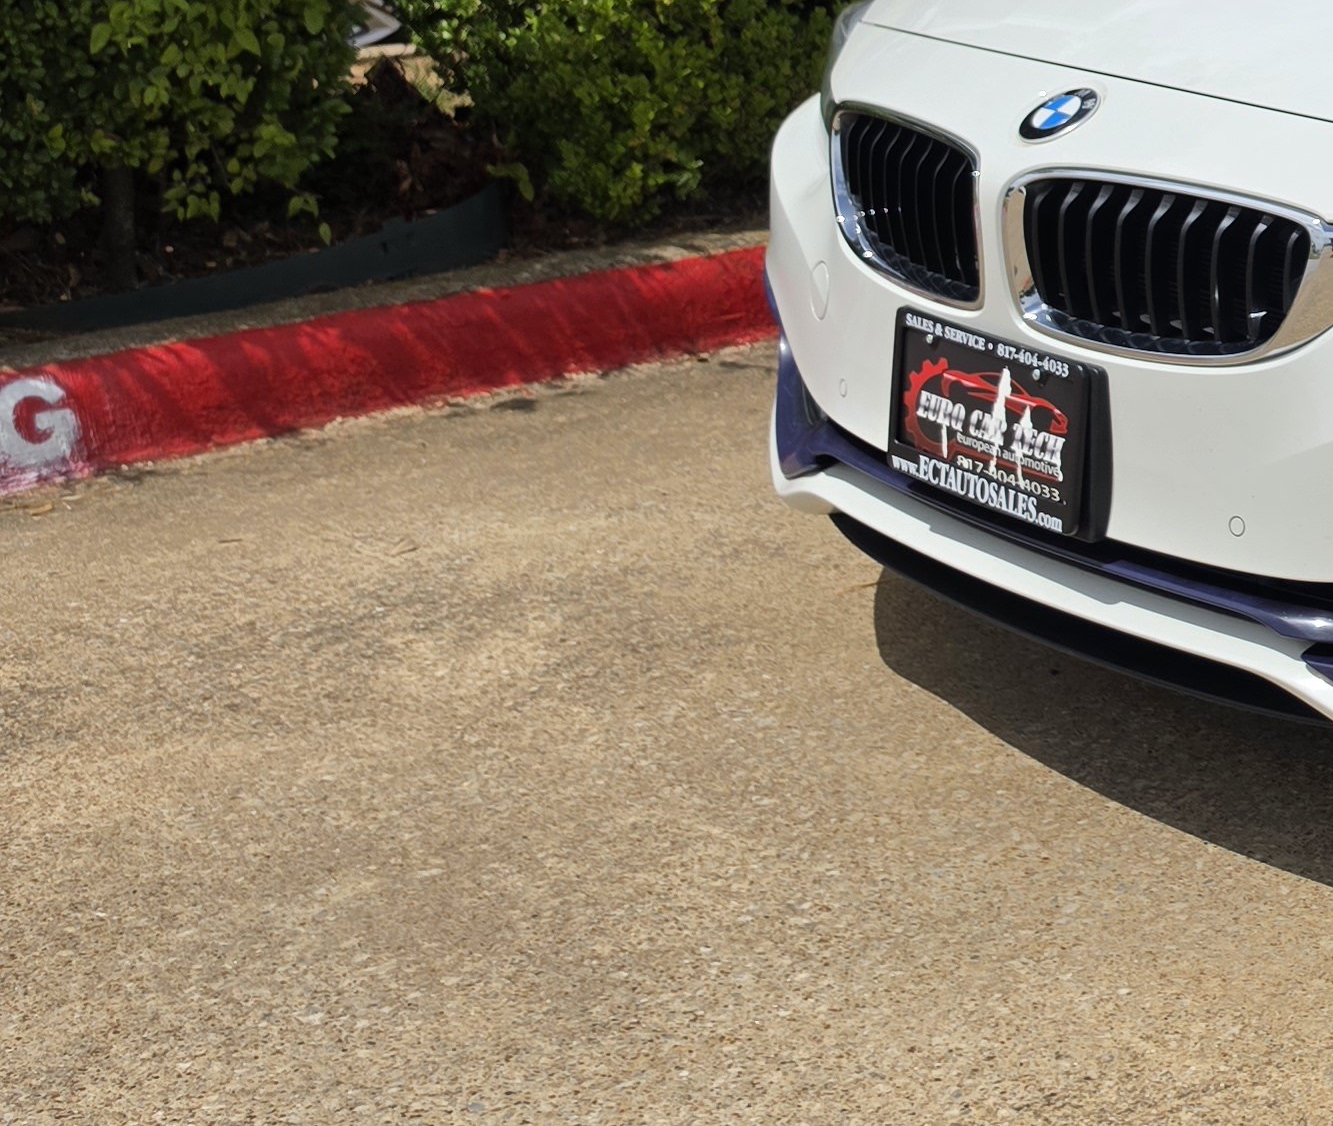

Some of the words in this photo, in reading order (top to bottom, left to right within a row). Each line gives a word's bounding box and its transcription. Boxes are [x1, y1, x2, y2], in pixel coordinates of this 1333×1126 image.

[906, 313, 933, 333] SALES
[934, 323, 943, 337] &
[944, 325, 986, 351] SERVICE
[996, 343, 1070, 378] 817-404-4033
[916, 390, 966, 432] EURO
[1010, 423, 1066, 465] TECH
[891, 454, 1063, 533] www.ECTAUTOSALES.com
[1002, 448, 1062, 478] auomotive
